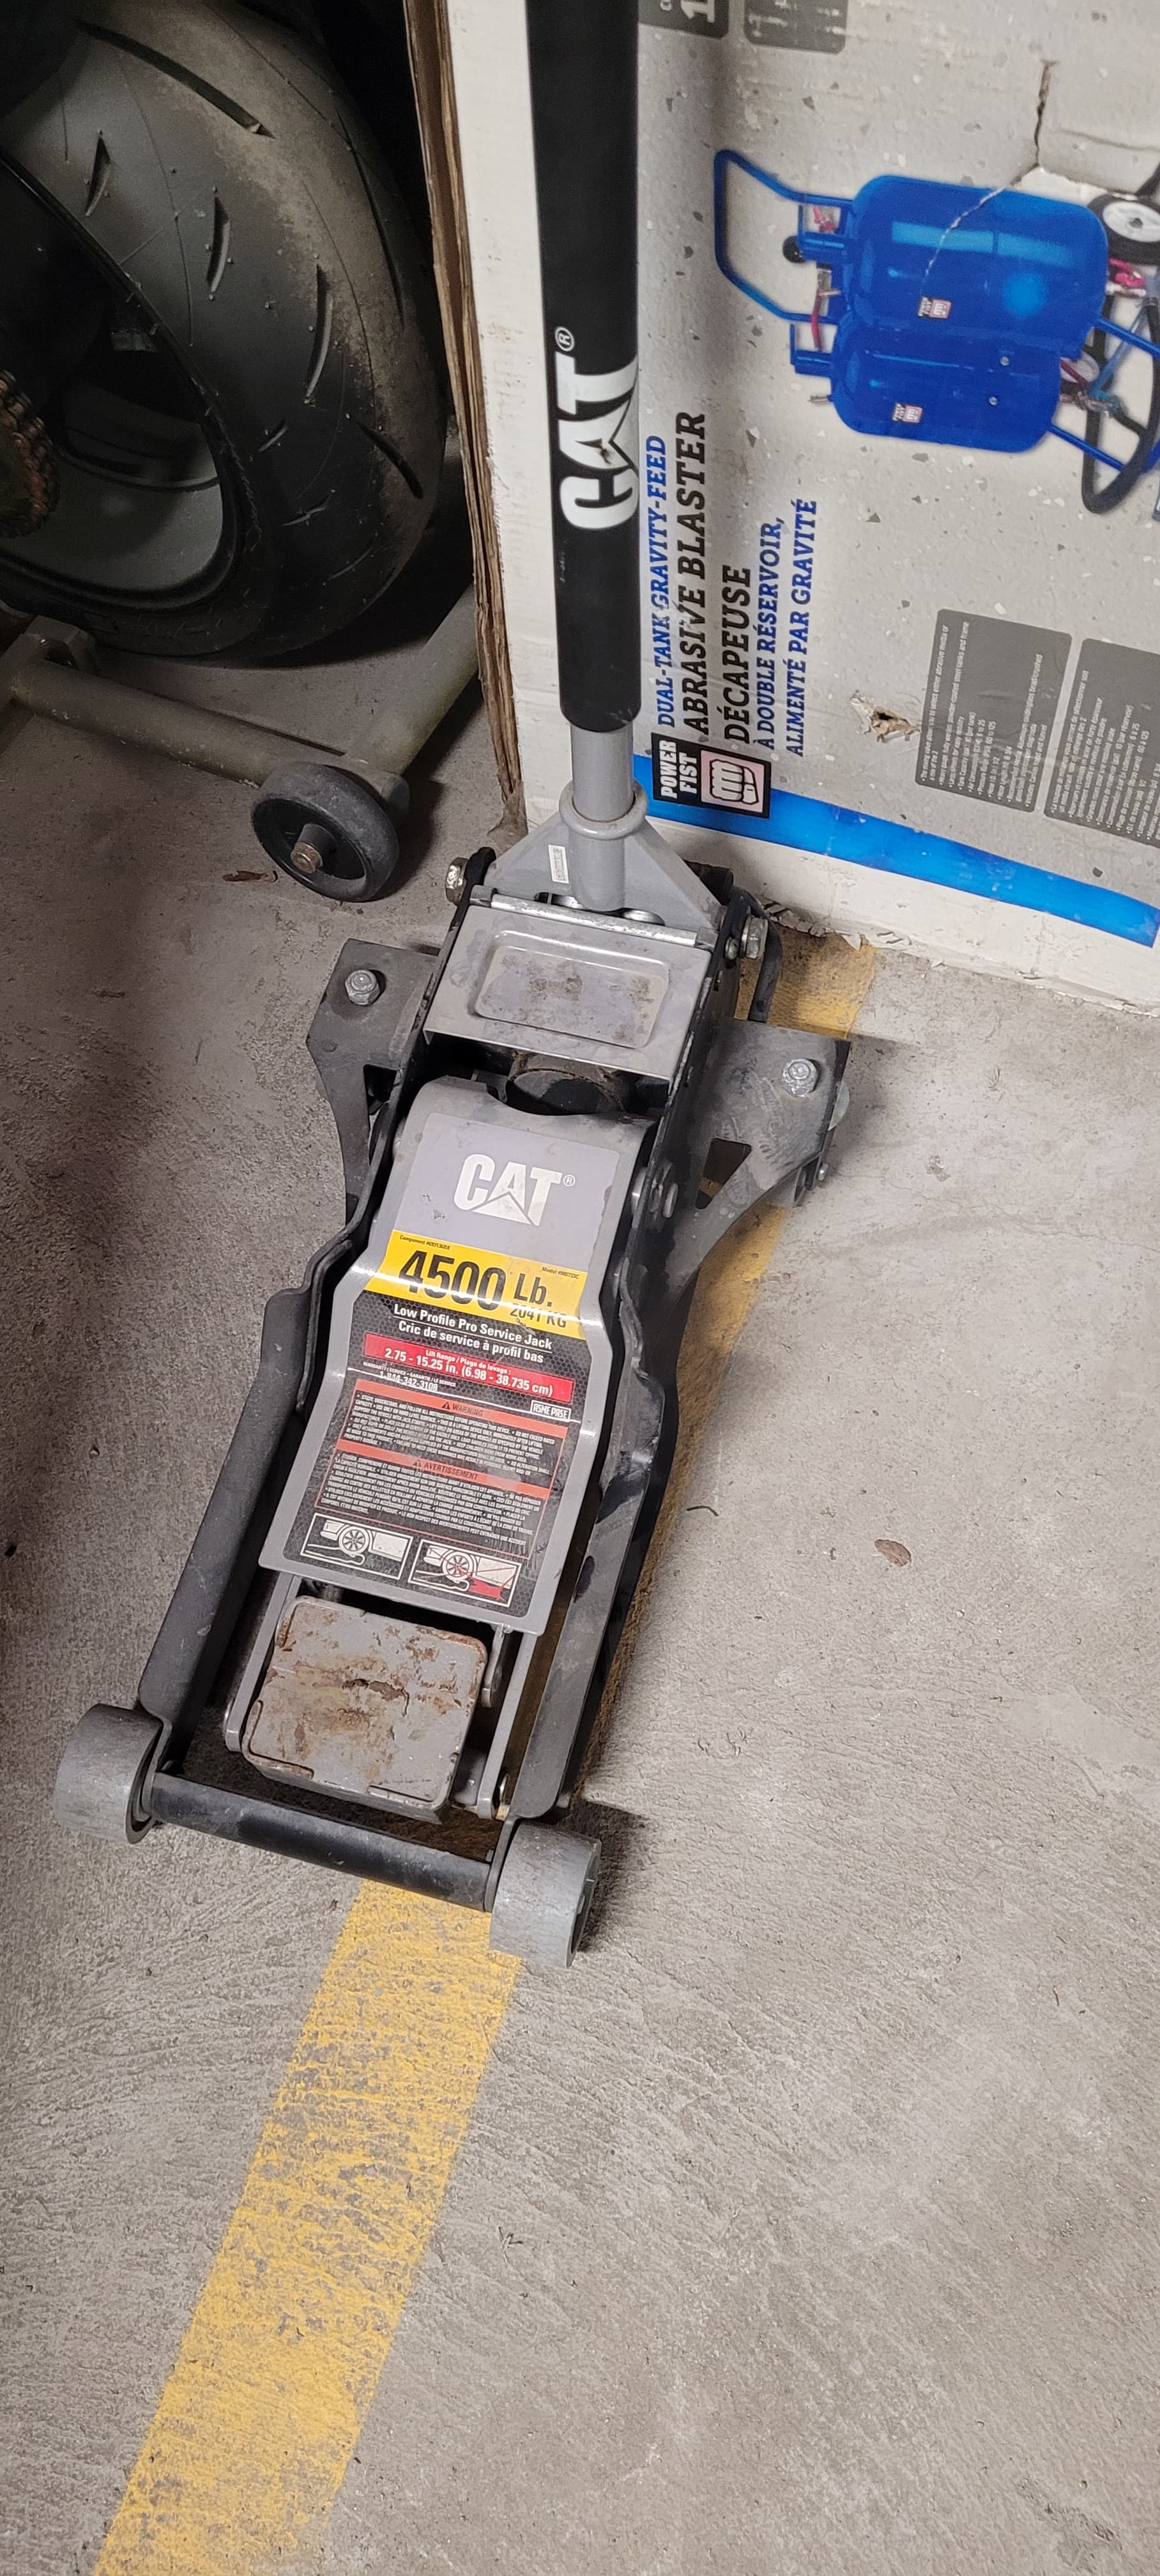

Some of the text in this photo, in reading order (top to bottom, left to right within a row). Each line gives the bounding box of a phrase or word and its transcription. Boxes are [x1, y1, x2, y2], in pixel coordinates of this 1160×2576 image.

[646, 435, 675, 728] DUAL-TANK GRAVITY-FEED
[673, 411, 709, 735] ABRASIVE BLASTER
[753, 516, 784, 749] À DOUBLE RÉSERVOIR,
[781, 498, 816, 756] ALIMENTÉ PAR GRAVITÉ
[938, 632, 947, 650] media
[961, 620, 970, 639] frame
[720, 565, 752, 744] DÉCAPEUSE
[935, 650, 945, 675] abrasive
[659, 740, 678, 799] POWER
[679, 752, 698, 794] FIST
[397, 1250, 553, 1312] 4500 Lb.
[393, 1303, 553, 1350] Low Profile Pro Service Jack
[509, 1302, 569, 1328] 2041 KG
[397, 1320, 544, 1363] Cric de service à profil bas
[425, 1349, 436, 1358] Lift
[436, 1352, 455, 1363] Range
[459, 1357, 478, 1368] Plage
[486, 1364, 507, 1375] levage
[383, 1347, 407, 1362] 2.75
[414, 1354, 444, 1370] 15.25
[445, 1361, 460, 1374] in.
[460, 1364, 487, 1382] (6.98
[530, 1381, 553, 1397] cm)
[451, 1402, 484, 1418] WARNING
[533, 1403, 568, 1418] ASME PASE
[423, 1461, 479, 1481] AVERTISSEMENT
